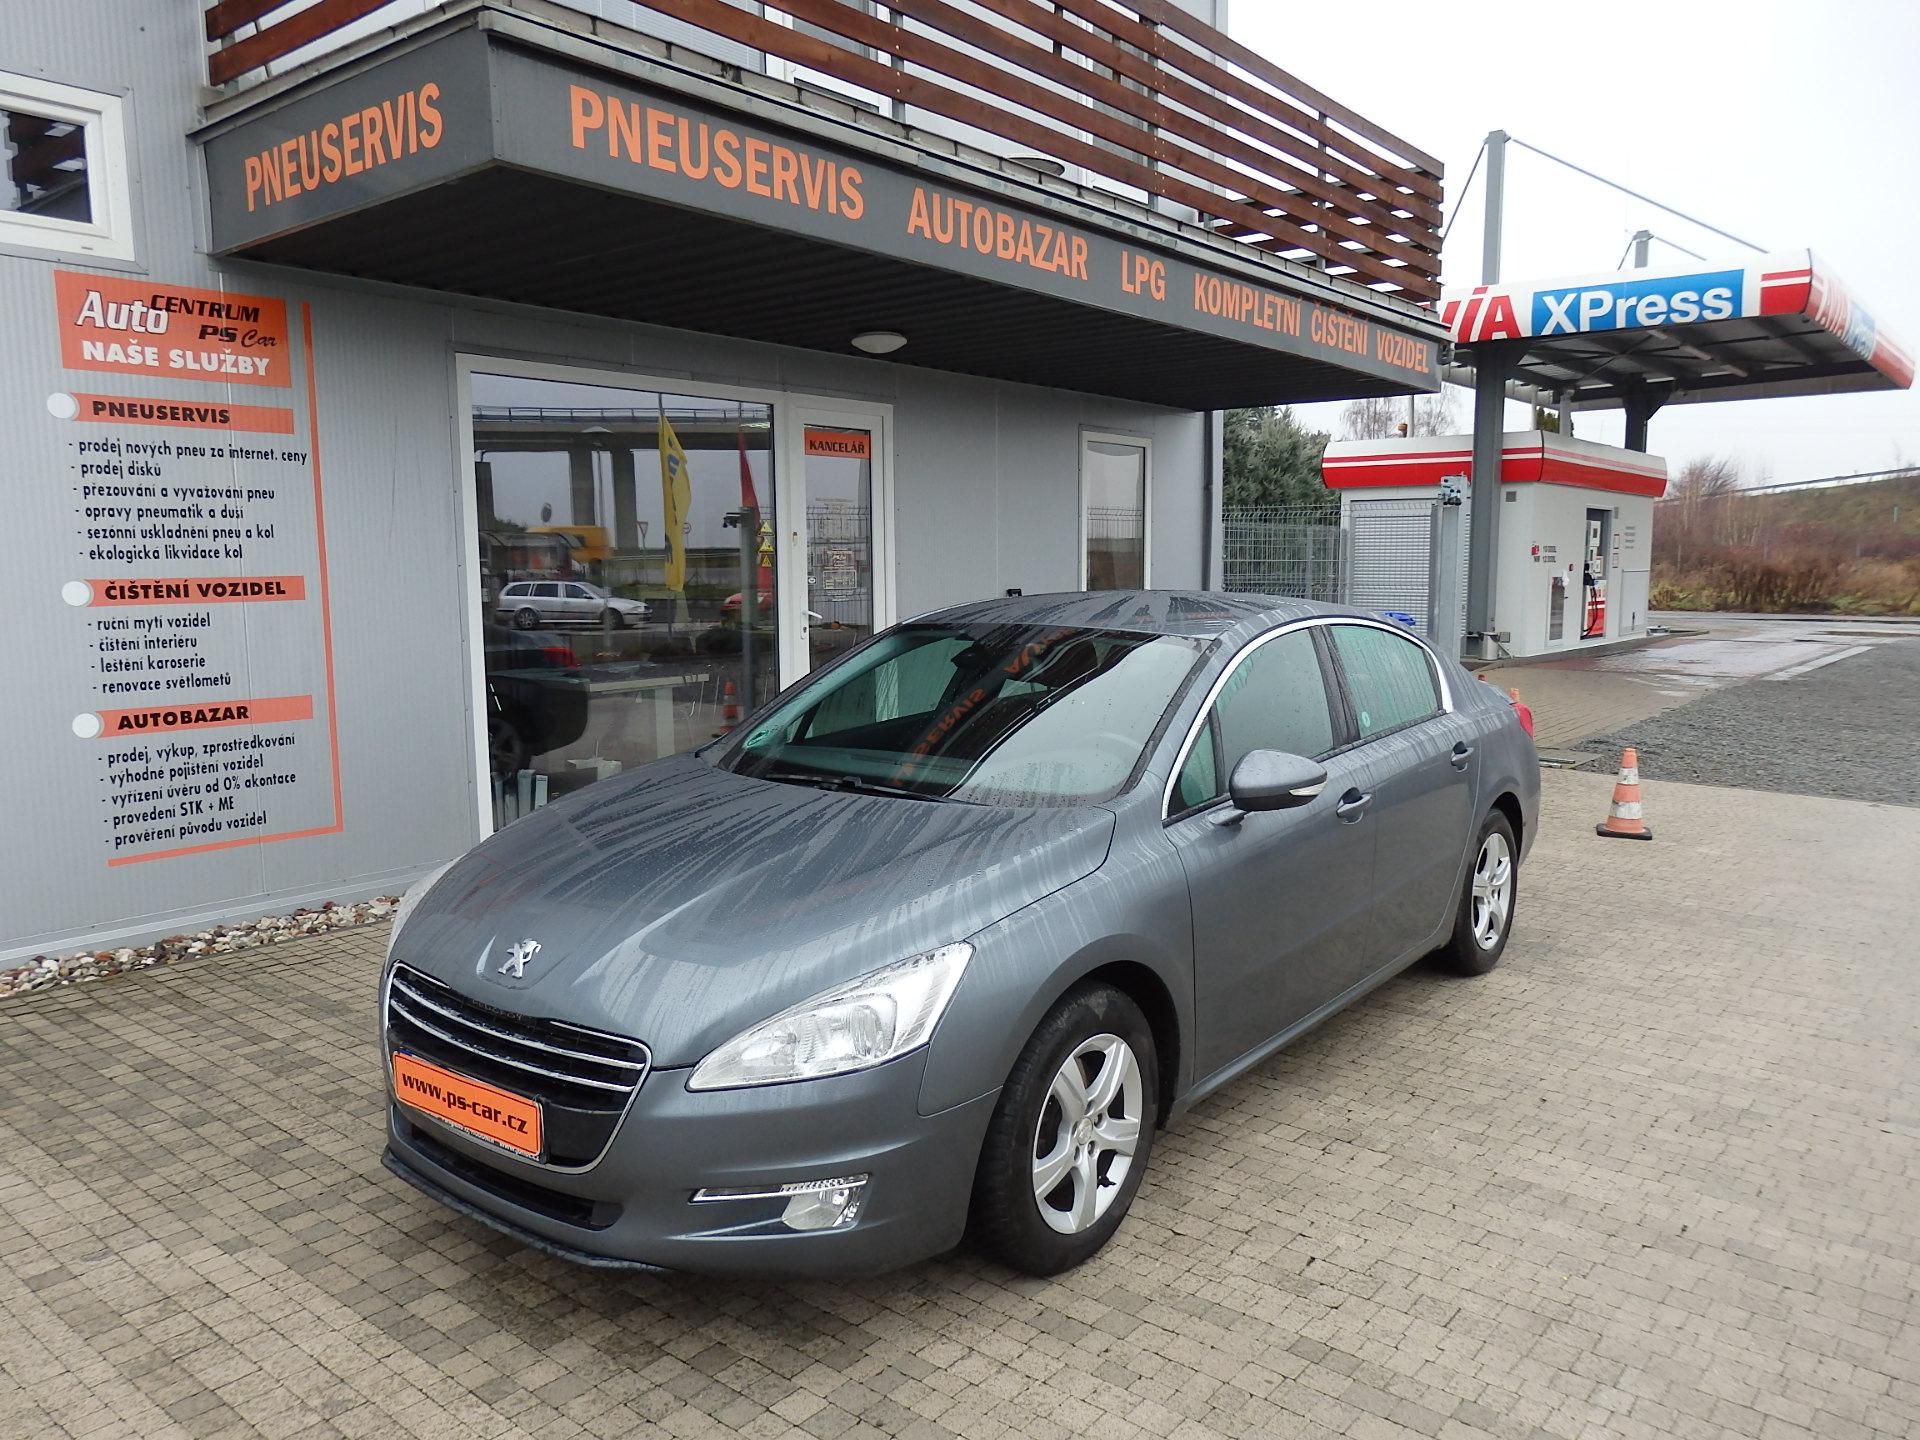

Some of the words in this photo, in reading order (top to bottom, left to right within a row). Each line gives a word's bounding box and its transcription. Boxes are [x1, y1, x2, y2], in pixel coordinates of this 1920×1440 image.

[245, 82, 443, 212] PNEUSERVIS
[570, 84, 864, 220] PNEUSERVIS
[907, 187, 1088, 280] AUTOBAZAR
[1122, 250, 1166, 301] LPG
[1194, 271, 1303, 337] KOMPLETNÍ
[1311, 300, 1369, 356] ČIŠTĚNÍ
[1376, 330, 1429, 374] VOZIDEL
[74, 289, 169, 334] Auto
[151, 294, 260, 322] CENTRUM
[1541, 287, 1733, 337] XPress
[199, 325, 238, 342] PS
[241, 329, 280, 347] Car
[82, 339, 160, 367] NAŠE
[169, 348, 270, 376] SLUŽBY
[93, 400, 231, 424] PNEUSERVIS
[79, 437, 122, 457] prodej
[126, 440, 172, 459] nových
[176, 446, 206, 460] pneu
[210, 447, 224, 458] za
[229, 443, 277, 460] internet.
[281, 451, 307, 465] ceny
[809, 439, 865, 454] KANCELÁŘ
[81, 459, 123, 479] prodej
[128, 460, 161, 476] disků
[83, 483, 157, 500] přezouvání
[161, 488, 168, 498] a
[173, 486, 243, 501] vyvažování
[247, 489, 275, 502] pneu
[85, 507, 132, 521] opravy
[137, 503, 203, 521] pneumatik
[208, 508, 216, 518] a
[140, 523, 208, 539] uskladnění
[212, 528, 241, 542] pneu
[245, 529, 252, 538] a
[256, 524, 274, 538] kol
[90, 544, 160, 563] ekologická
[164, 544, 220, 559] likvidace
[224, 543, 243, 559] kol
[105, 579, 190, 600] ČIŠTĚNÍ
[197, 582, 286, 598] VOZIDEL
[97, 616, 129, 630] ruční
[134, 615, 163, 633] mytí
[167, 612, 210, 628] vozidel
[144, 633, 197, 649] interiéru
[101, 657, 143, 672] leštění
[147, 653, 206, 670] karoserie
[102, 680, 161, 693] renovace
[166, 672, 231, 689] světlometů
[118, 706, 249, 730] AUTOBAZAR
[203, 732, 295, 757] zprostředkování
[110, 765, 165, 788] výhodné
[170, 759, 219, 786] pojištění
[223, 753, 264, 771] vozidel
[167, 783, 201, 804] úvěru
[205, 773, 219, 793] od
[223, 770, 240, 791] 0%
[245, 768, 296, 788] akontace
[113, 804, 176, 829] provedení
[180, 800, 204, 817] STK
[219, 796, 234, 811] ME
[115, 824, 176, 850] prověření
[179, 816, 222, 839] původu
[226, 810, 267, 834] vozidel
[402, 1073, 528, 1134] www.ps-car.cz
